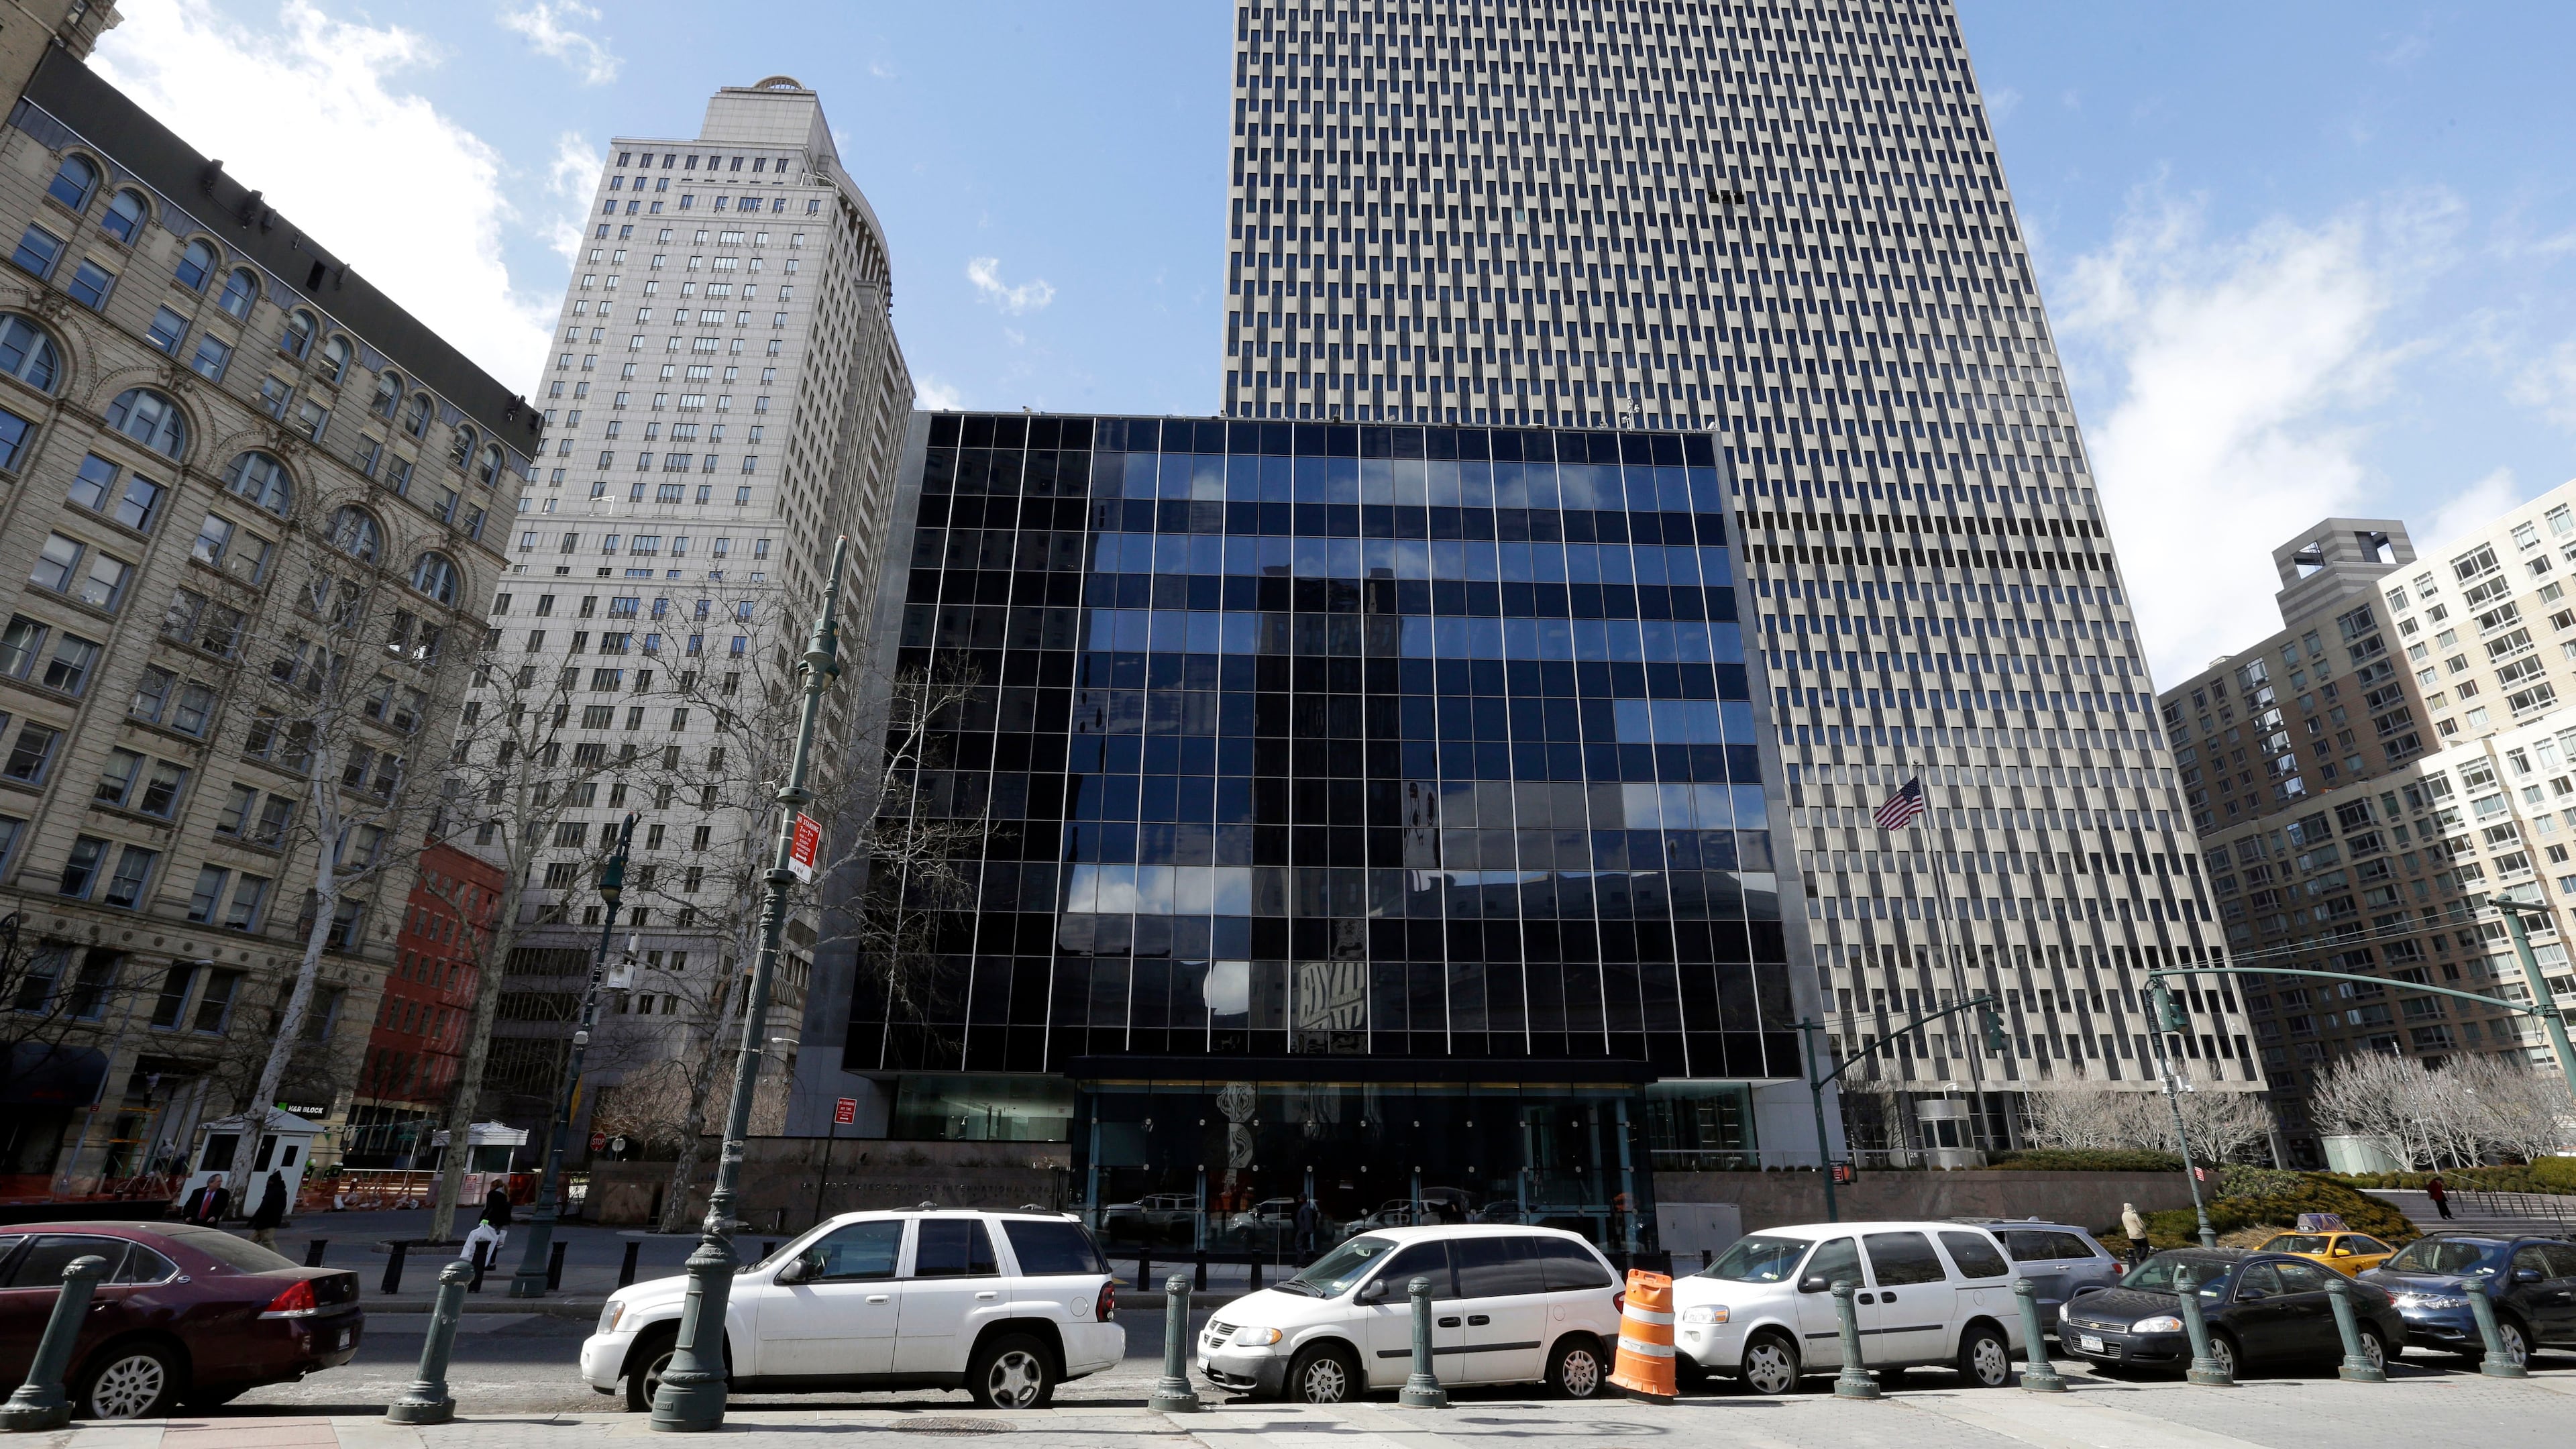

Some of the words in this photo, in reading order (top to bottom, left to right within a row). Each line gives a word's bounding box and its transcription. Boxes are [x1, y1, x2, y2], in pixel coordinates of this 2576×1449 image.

[797, 815, 802, 823] NO
[803, 819, 818, 833] STANDING
[302, 1106, 323, 1114] BLOCK
[943, 1183, 1025, 1193] INTERNATIONAL
